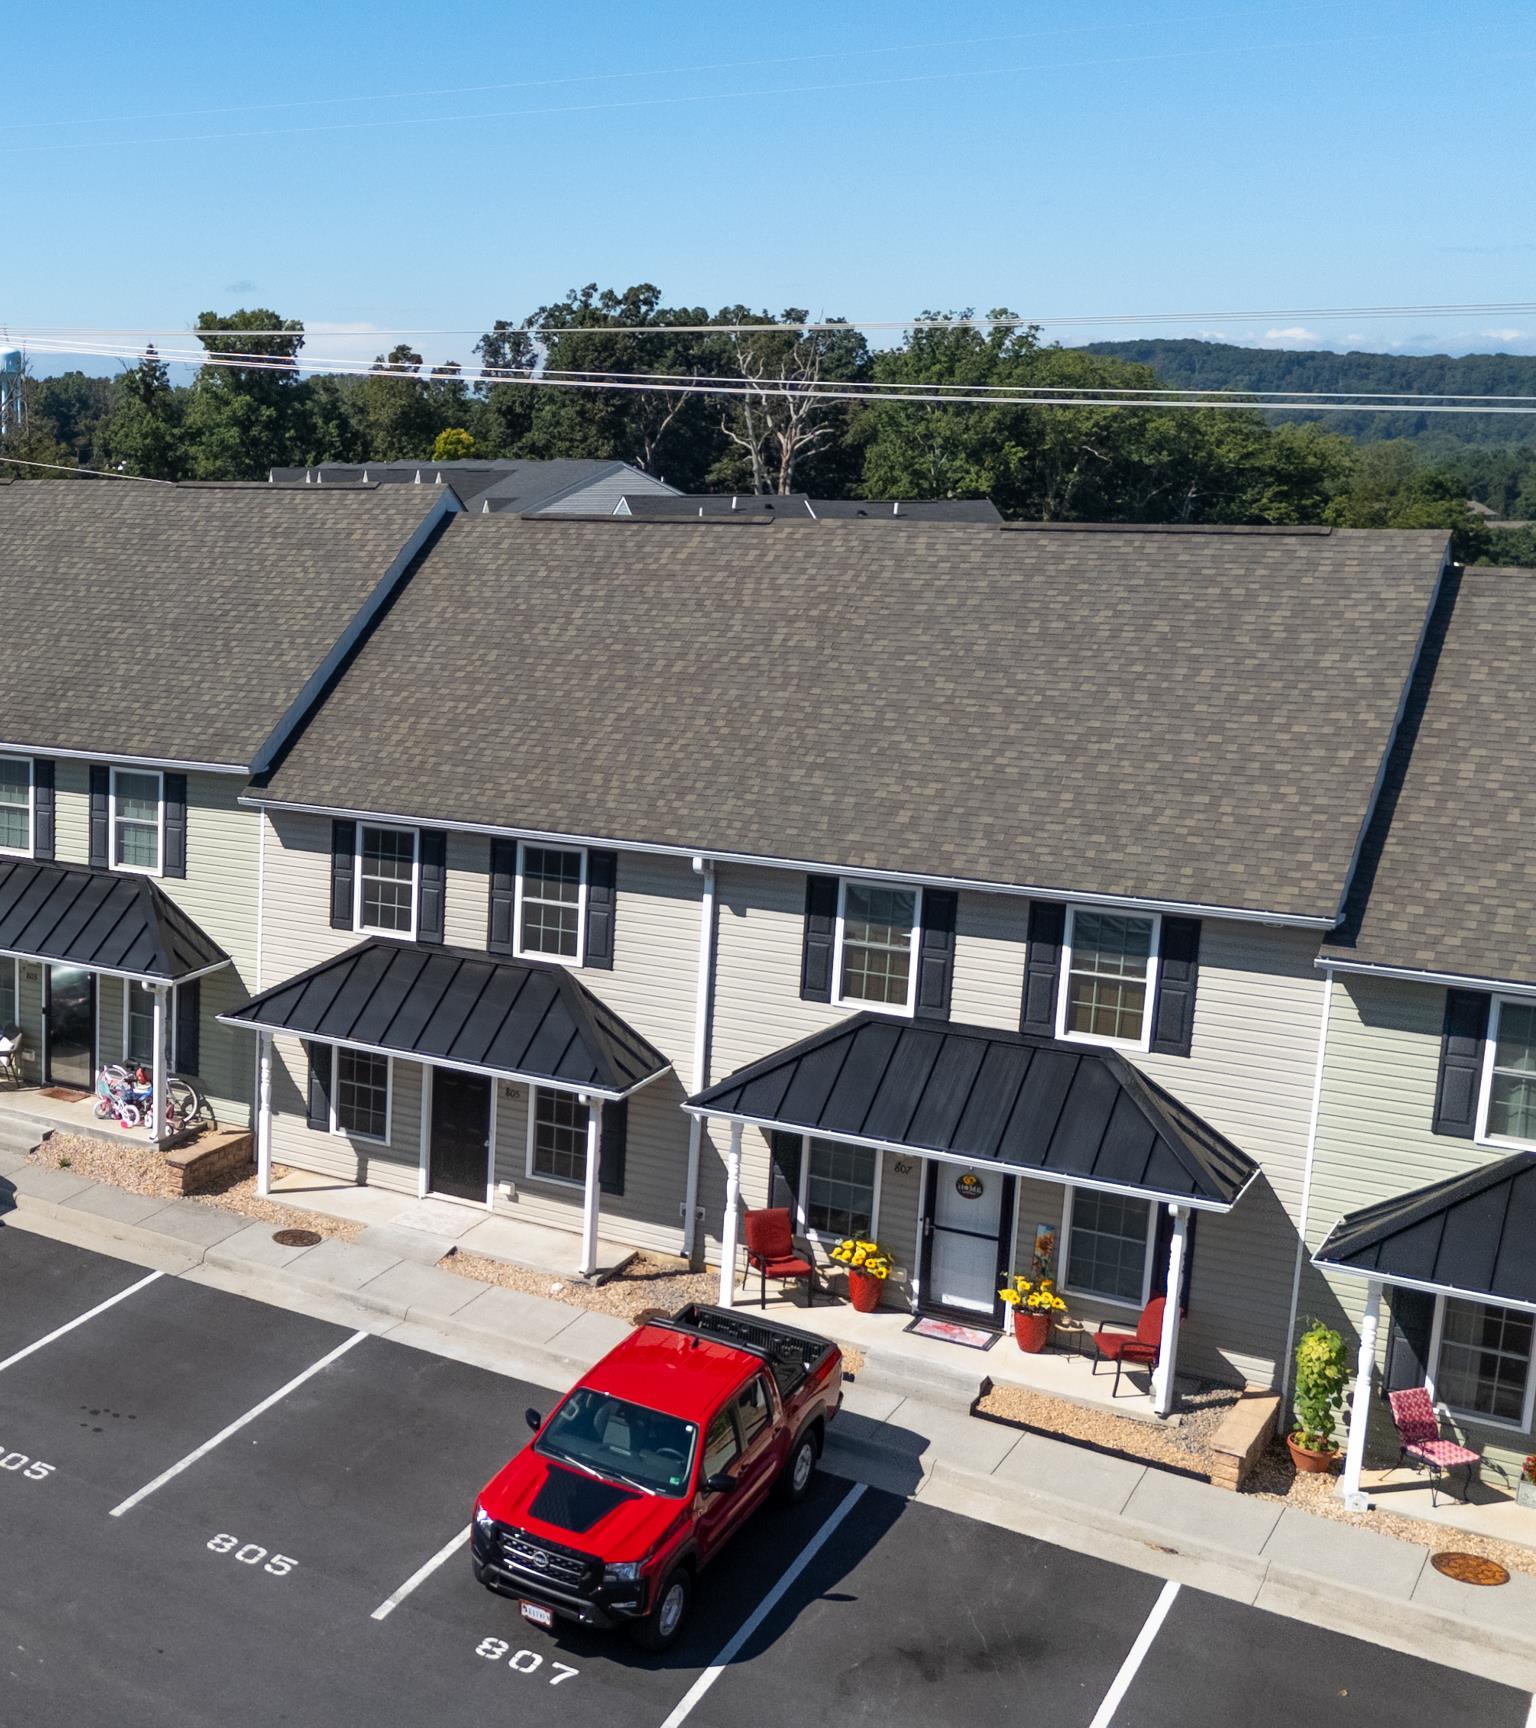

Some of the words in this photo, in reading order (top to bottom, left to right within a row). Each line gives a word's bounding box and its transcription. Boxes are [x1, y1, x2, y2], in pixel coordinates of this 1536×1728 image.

[505, 1087, 521, 1098] 805
[894, 1161, 913, 1175] 807
[207, 1533, 299, 1577] 805
[474, 1636, 581, 1687] 807
